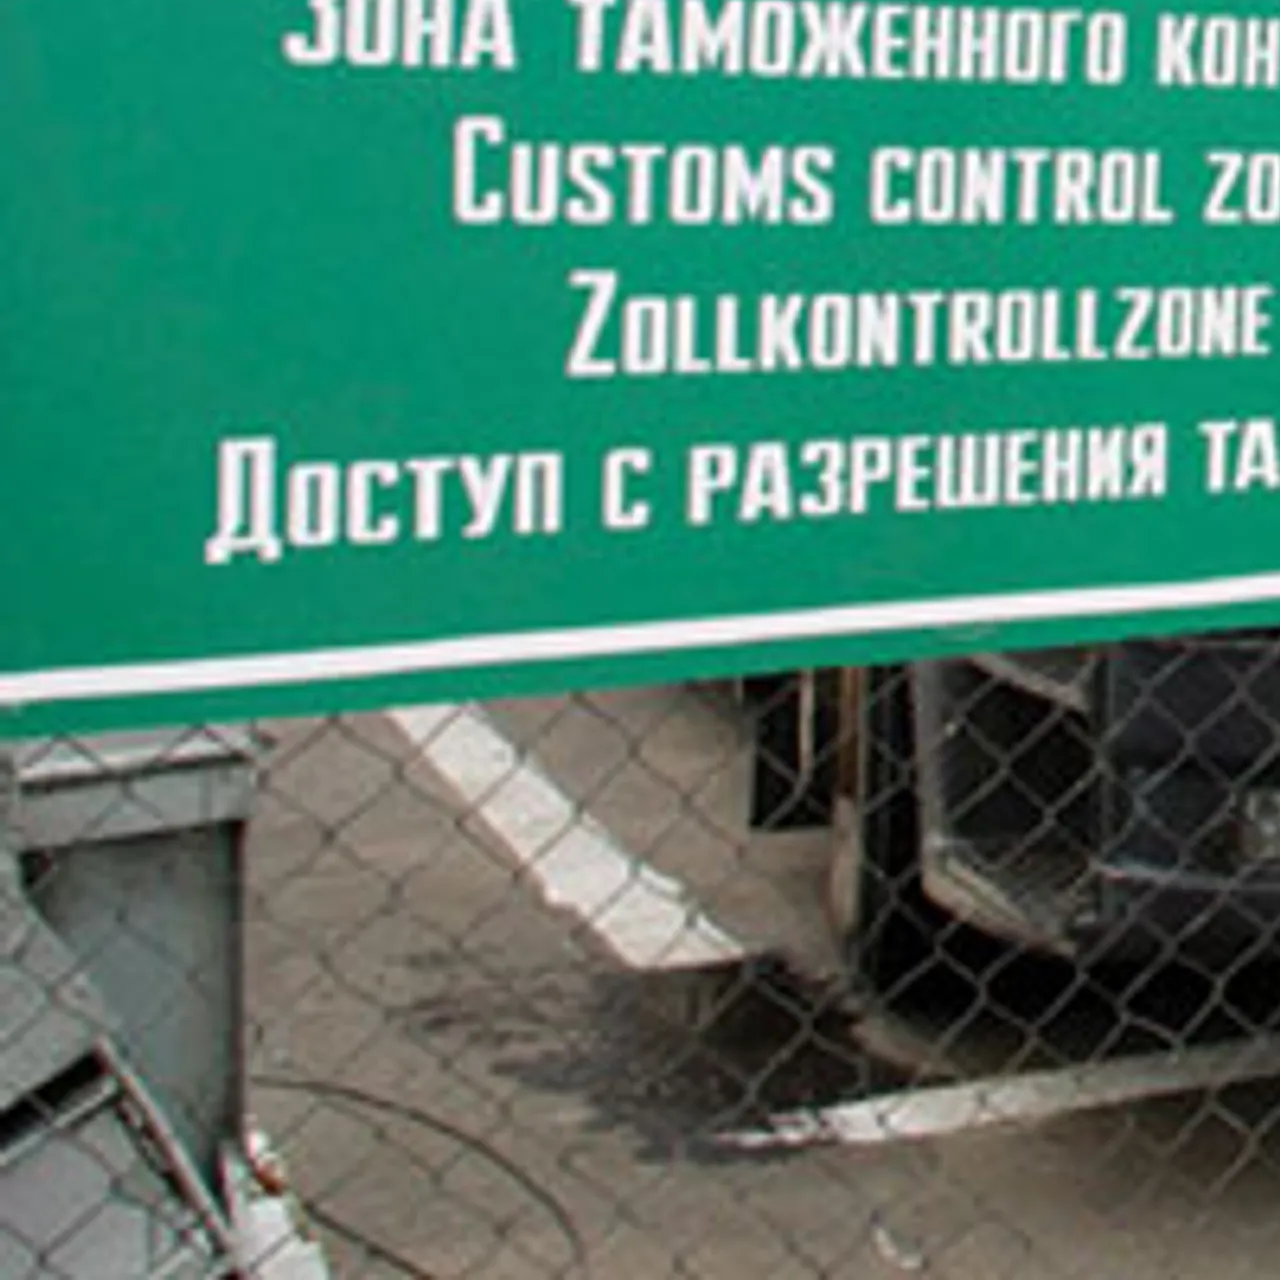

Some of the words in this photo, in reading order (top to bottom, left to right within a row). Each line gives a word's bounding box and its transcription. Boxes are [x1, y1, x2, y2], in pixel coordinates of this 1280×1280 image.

[452, 114, 835, 226] CUSTOMS
[869, 146, 1175, 225] CONTROL
[564, 268, 1273, 378] ZOLLKONTROLLZONE
[204, 436, 563, 565] ДОСТУП
[601, 447, 651, 530] С
[687, 422, 1168, 526] РАЗРЕШЕНИЯ
